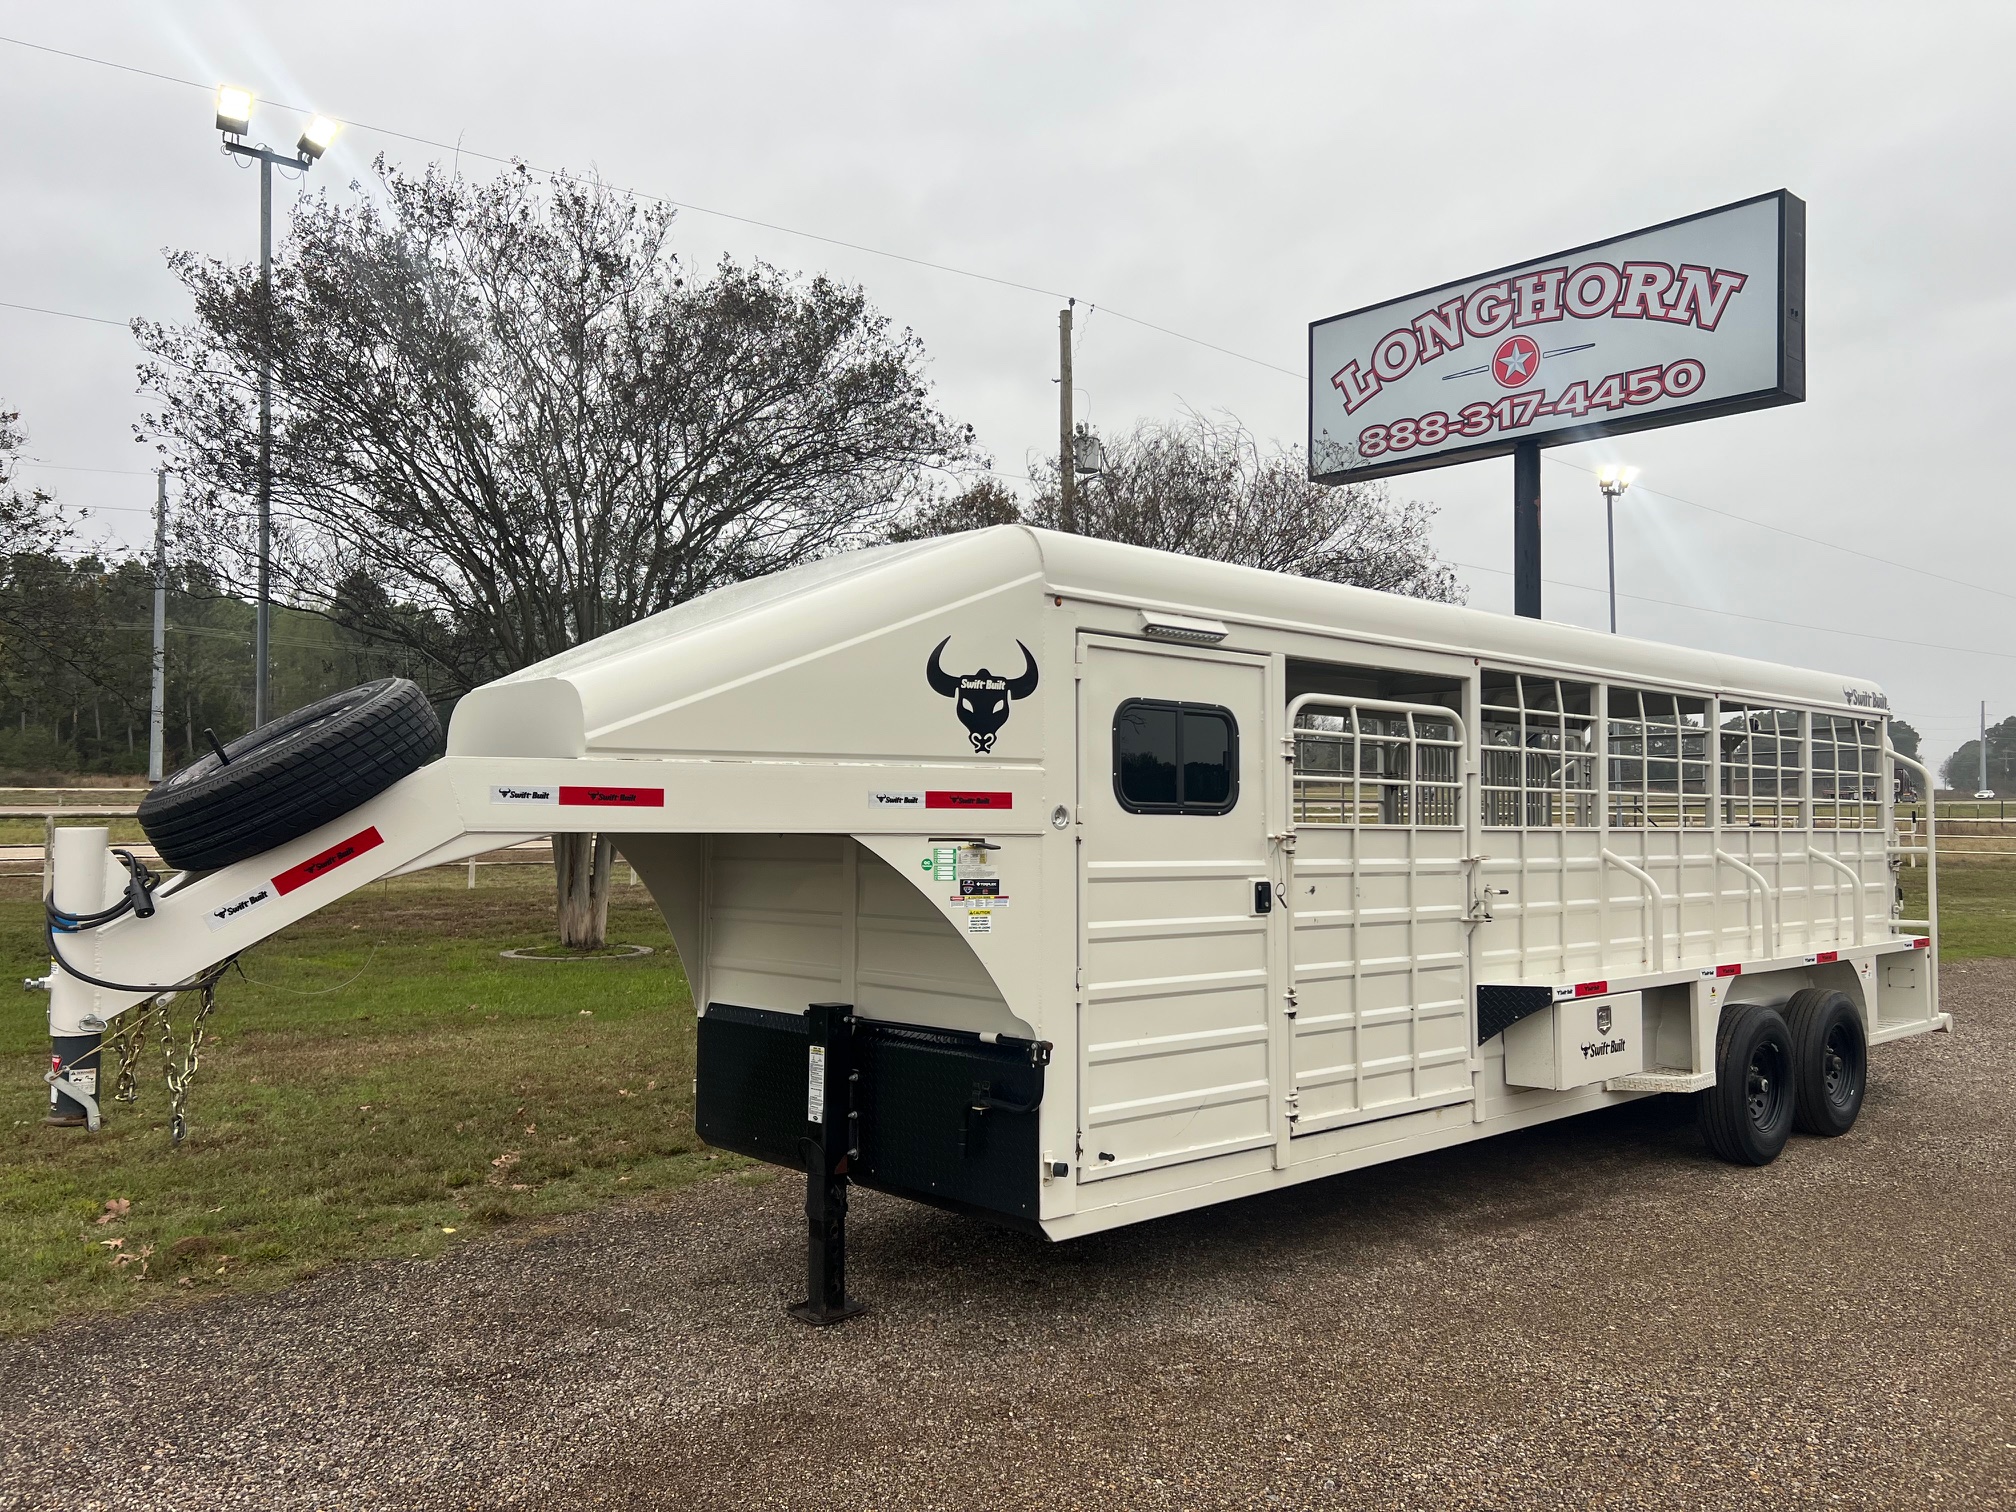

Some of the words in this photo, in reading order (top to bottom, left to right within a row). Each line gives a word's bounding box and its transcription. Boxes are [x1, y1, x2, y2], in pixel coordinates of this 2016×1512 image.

[1331, 261, 1749, 416] LONGHORN
[1358, 358, 1706, 458] 888-317-4450
[960, 678, 986, 690] Swift
[986, 679, 1006, 691] Built
[1853, 688, 1872, 707] Swift
[1871, 691, 1888, 710] Built
[509, 790, 532, 800] Swift
[532, 791, 550, 800] Built
[599, 793, 619, 802] Swift
[885, 796, 904, 804] Swift
[904, 796, 919, 804] Built
[316, 855, 337, 871] Swift
[337, 846, 355, 860] Built
[226, 900, 250, 916] Swift
[249, 890, 269, 906] Built
[1589, 1041, 1611, 1058] Swift
[1610, 1038, 1626, 1054] Built
